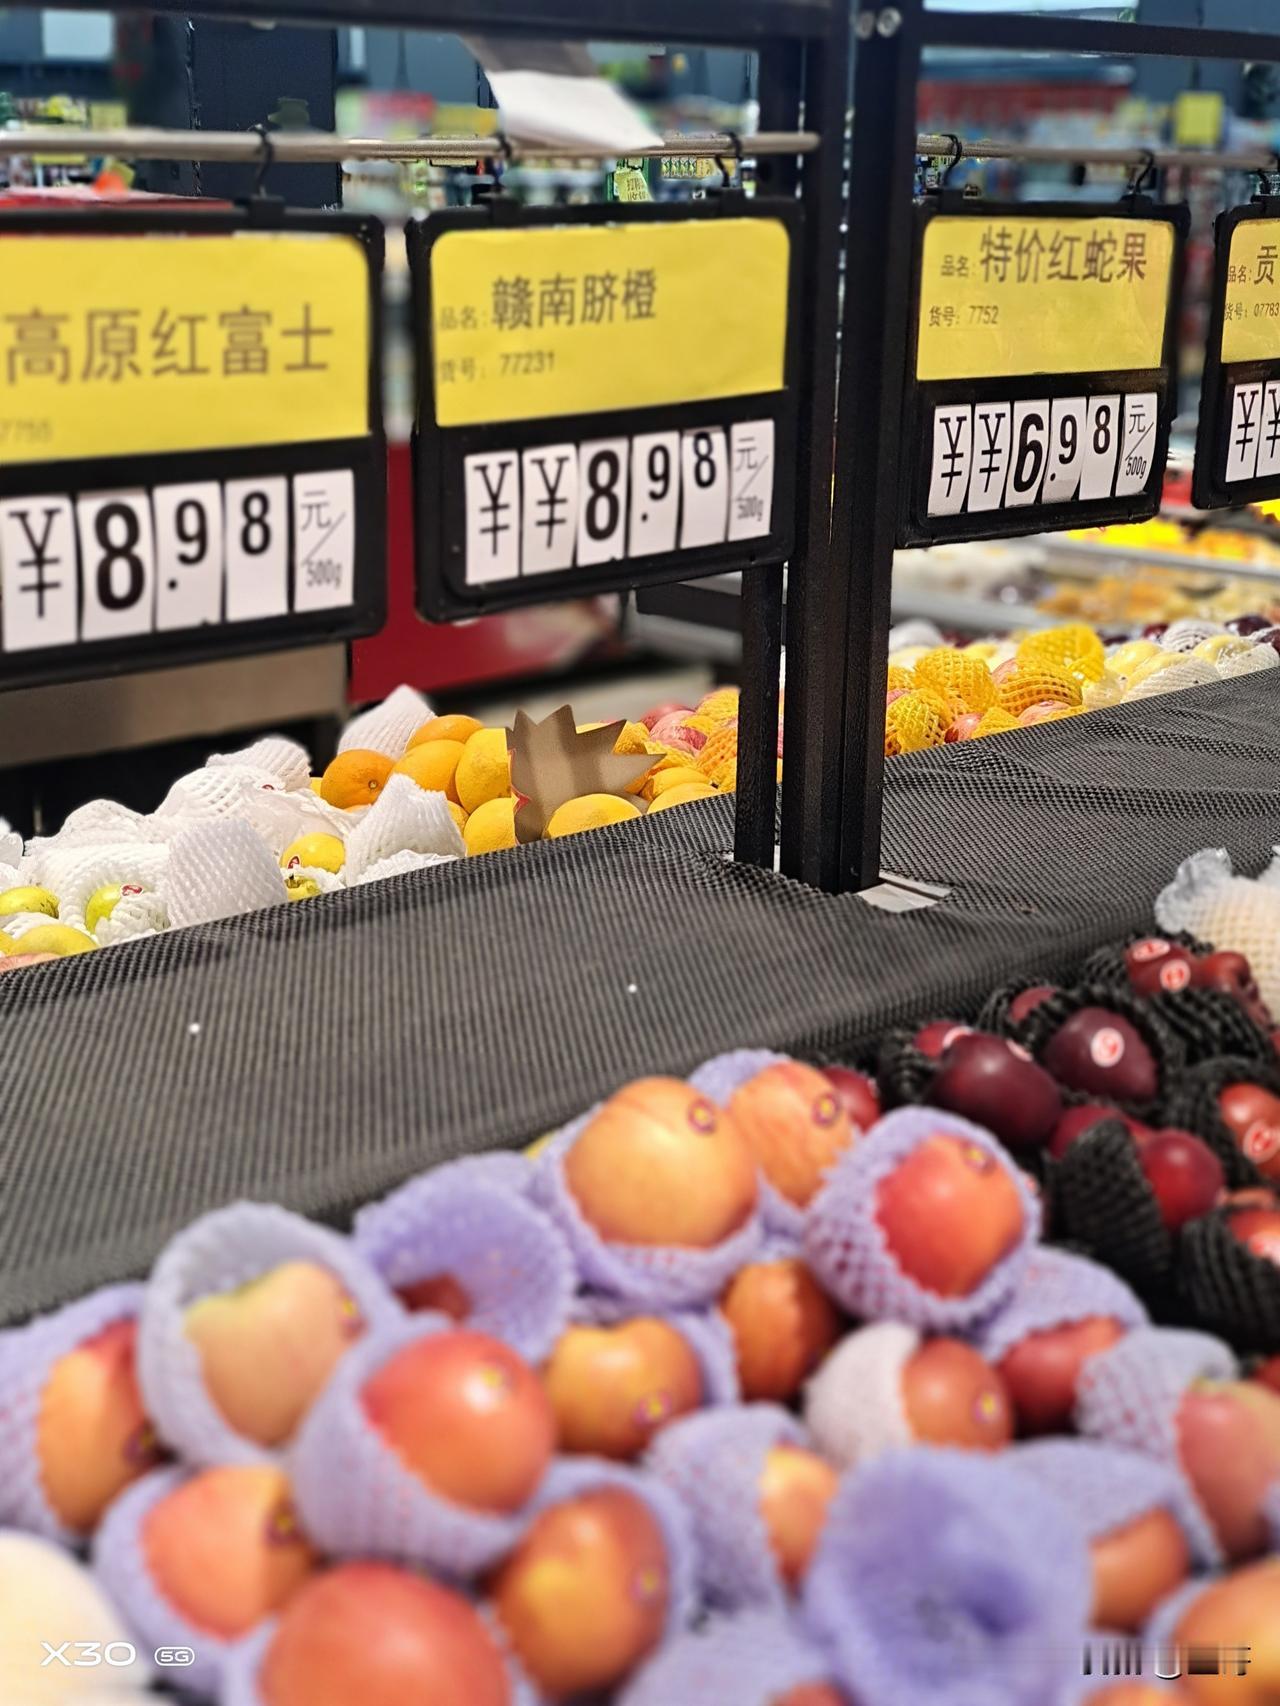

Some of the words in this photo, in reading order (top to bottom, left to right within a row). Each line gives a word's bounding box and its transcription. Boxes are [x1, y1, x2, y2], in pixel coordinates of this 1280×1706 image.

[979, 225, 1148, 283] 特价红蛇果
[1253, 245, 1279, 285] 贡
[492, 268, 657, 332] 赣南脐橙
[968, 304, 999, 325] 7752
[4, 302, 333, 387] 高原红富士
[500, 350, 555, 376] 77231
